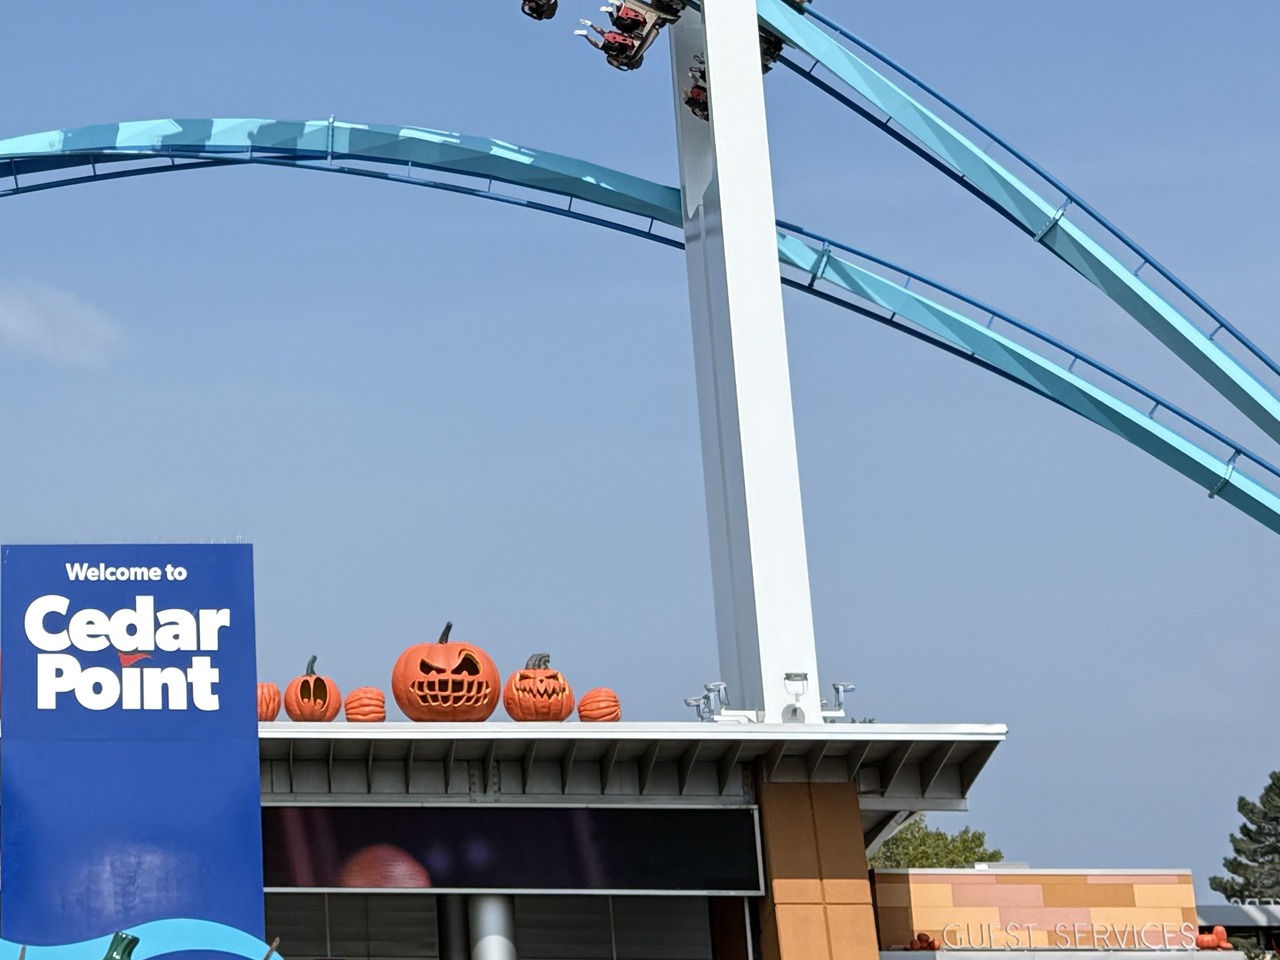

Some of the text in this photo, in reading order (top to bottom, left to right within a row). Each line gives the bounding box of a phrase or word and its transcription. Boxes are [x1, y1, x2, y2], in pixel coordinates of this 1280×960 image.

[65, 563, 188, 581] Welcome to
[24, 594, 231, 652] Cedar
[36, 653, 220, 711] Point
[942, 922, 1199, 951] GUEST SERVICES
